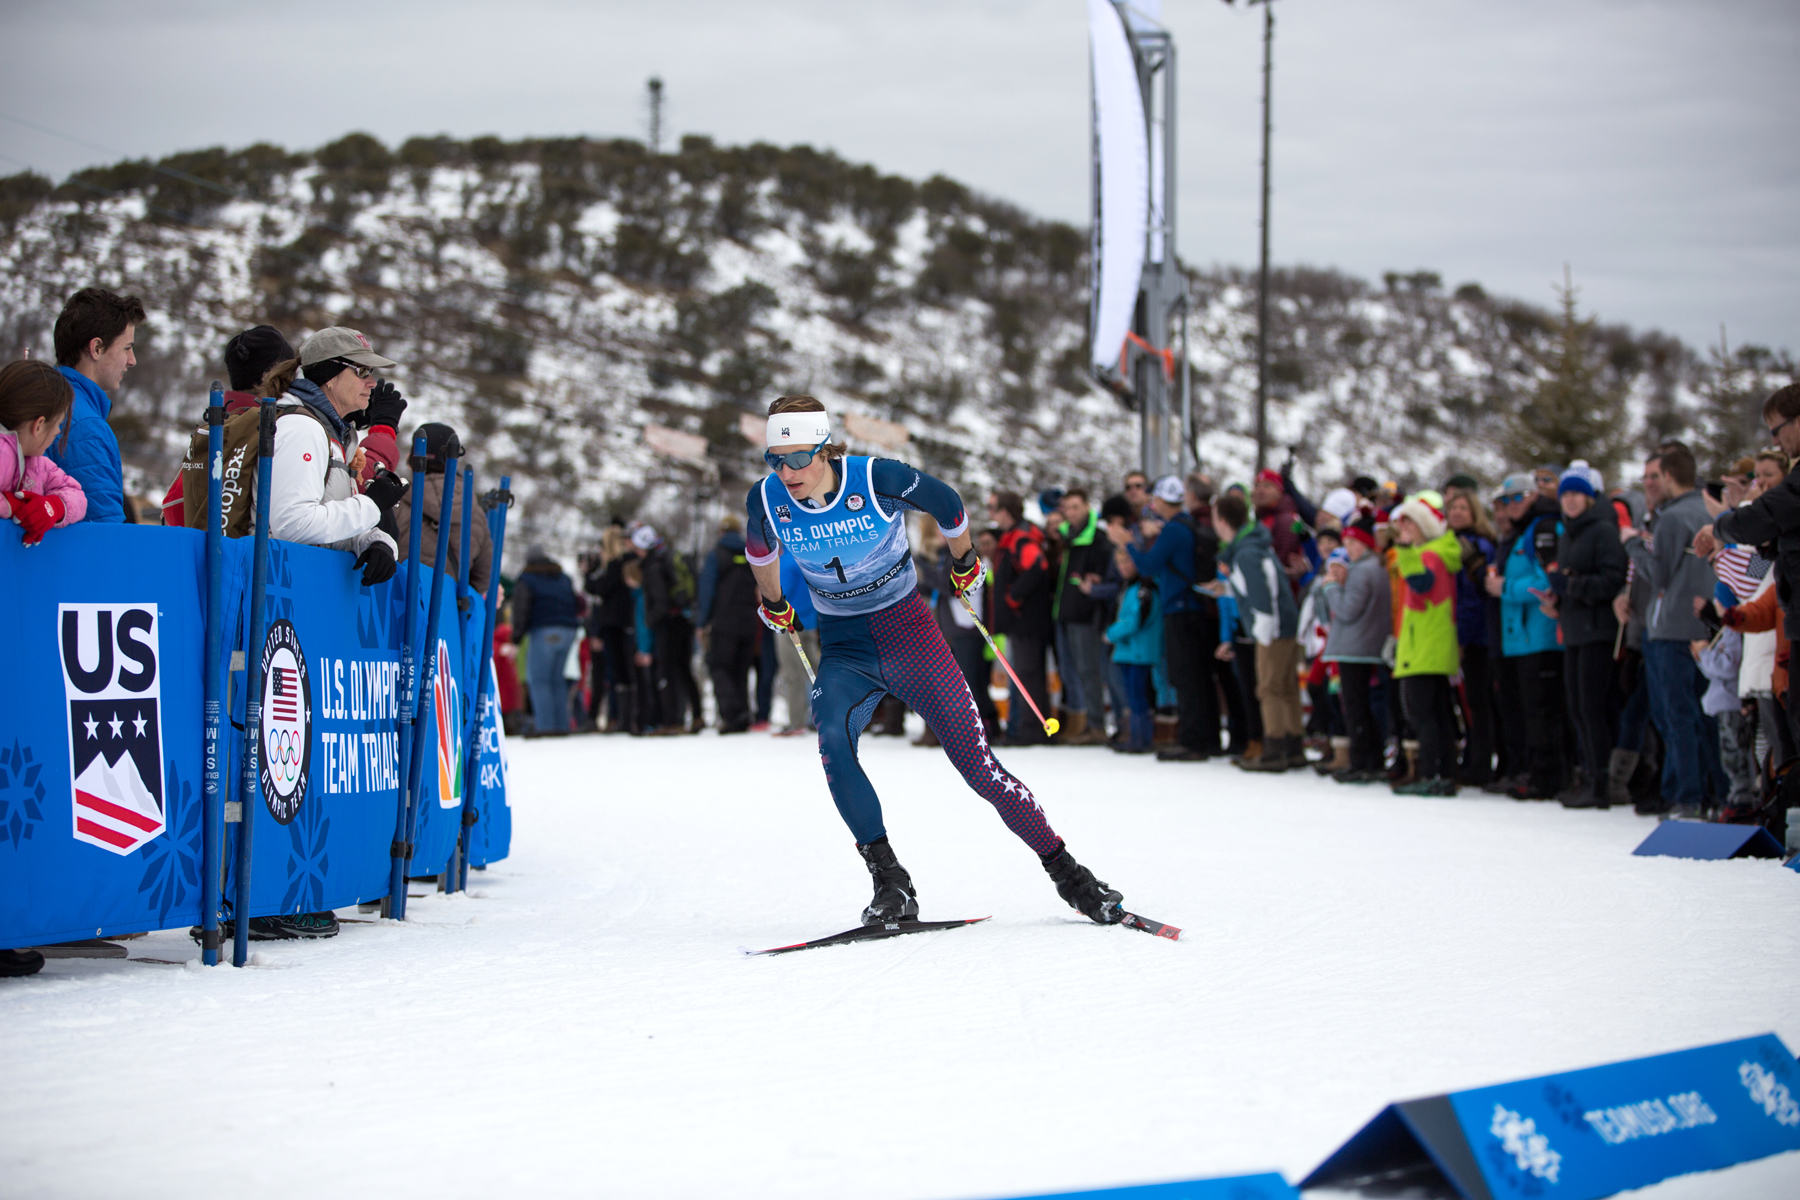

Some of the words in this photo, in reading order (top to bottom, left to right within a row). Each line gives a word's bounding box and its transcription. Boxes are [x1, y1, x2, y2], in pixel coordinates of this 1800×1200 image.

[182, 461, 204, 471] topaxi
[775, 505, 789, 514] US
[782, 527, 808, 543] U.S.
[810, 514, 875, 539] OLYMPIC
[785, 541, 821, 554] TEAM
[824, 530, 879, 549] TRIALS
[823, 556, 849, 584] 1
[825, 584, 875, 599] OLYMPIC
[876, 562, 903, 587] PARK
[62, 608, 157, 694] US
[261, 625, 283, 674] UNITED
[285, 625, 306, 679] STATES
[320, 656, 348, 720] U.S.
[350, 660, 400, 721] OLYMPIC
[321, 732, 360, 794] TEAM
[361, 731, 400, 793] TRIALS
[261, 768, 287, 819] OLYMPIC
[290, 771, 307, 814] TEAM
